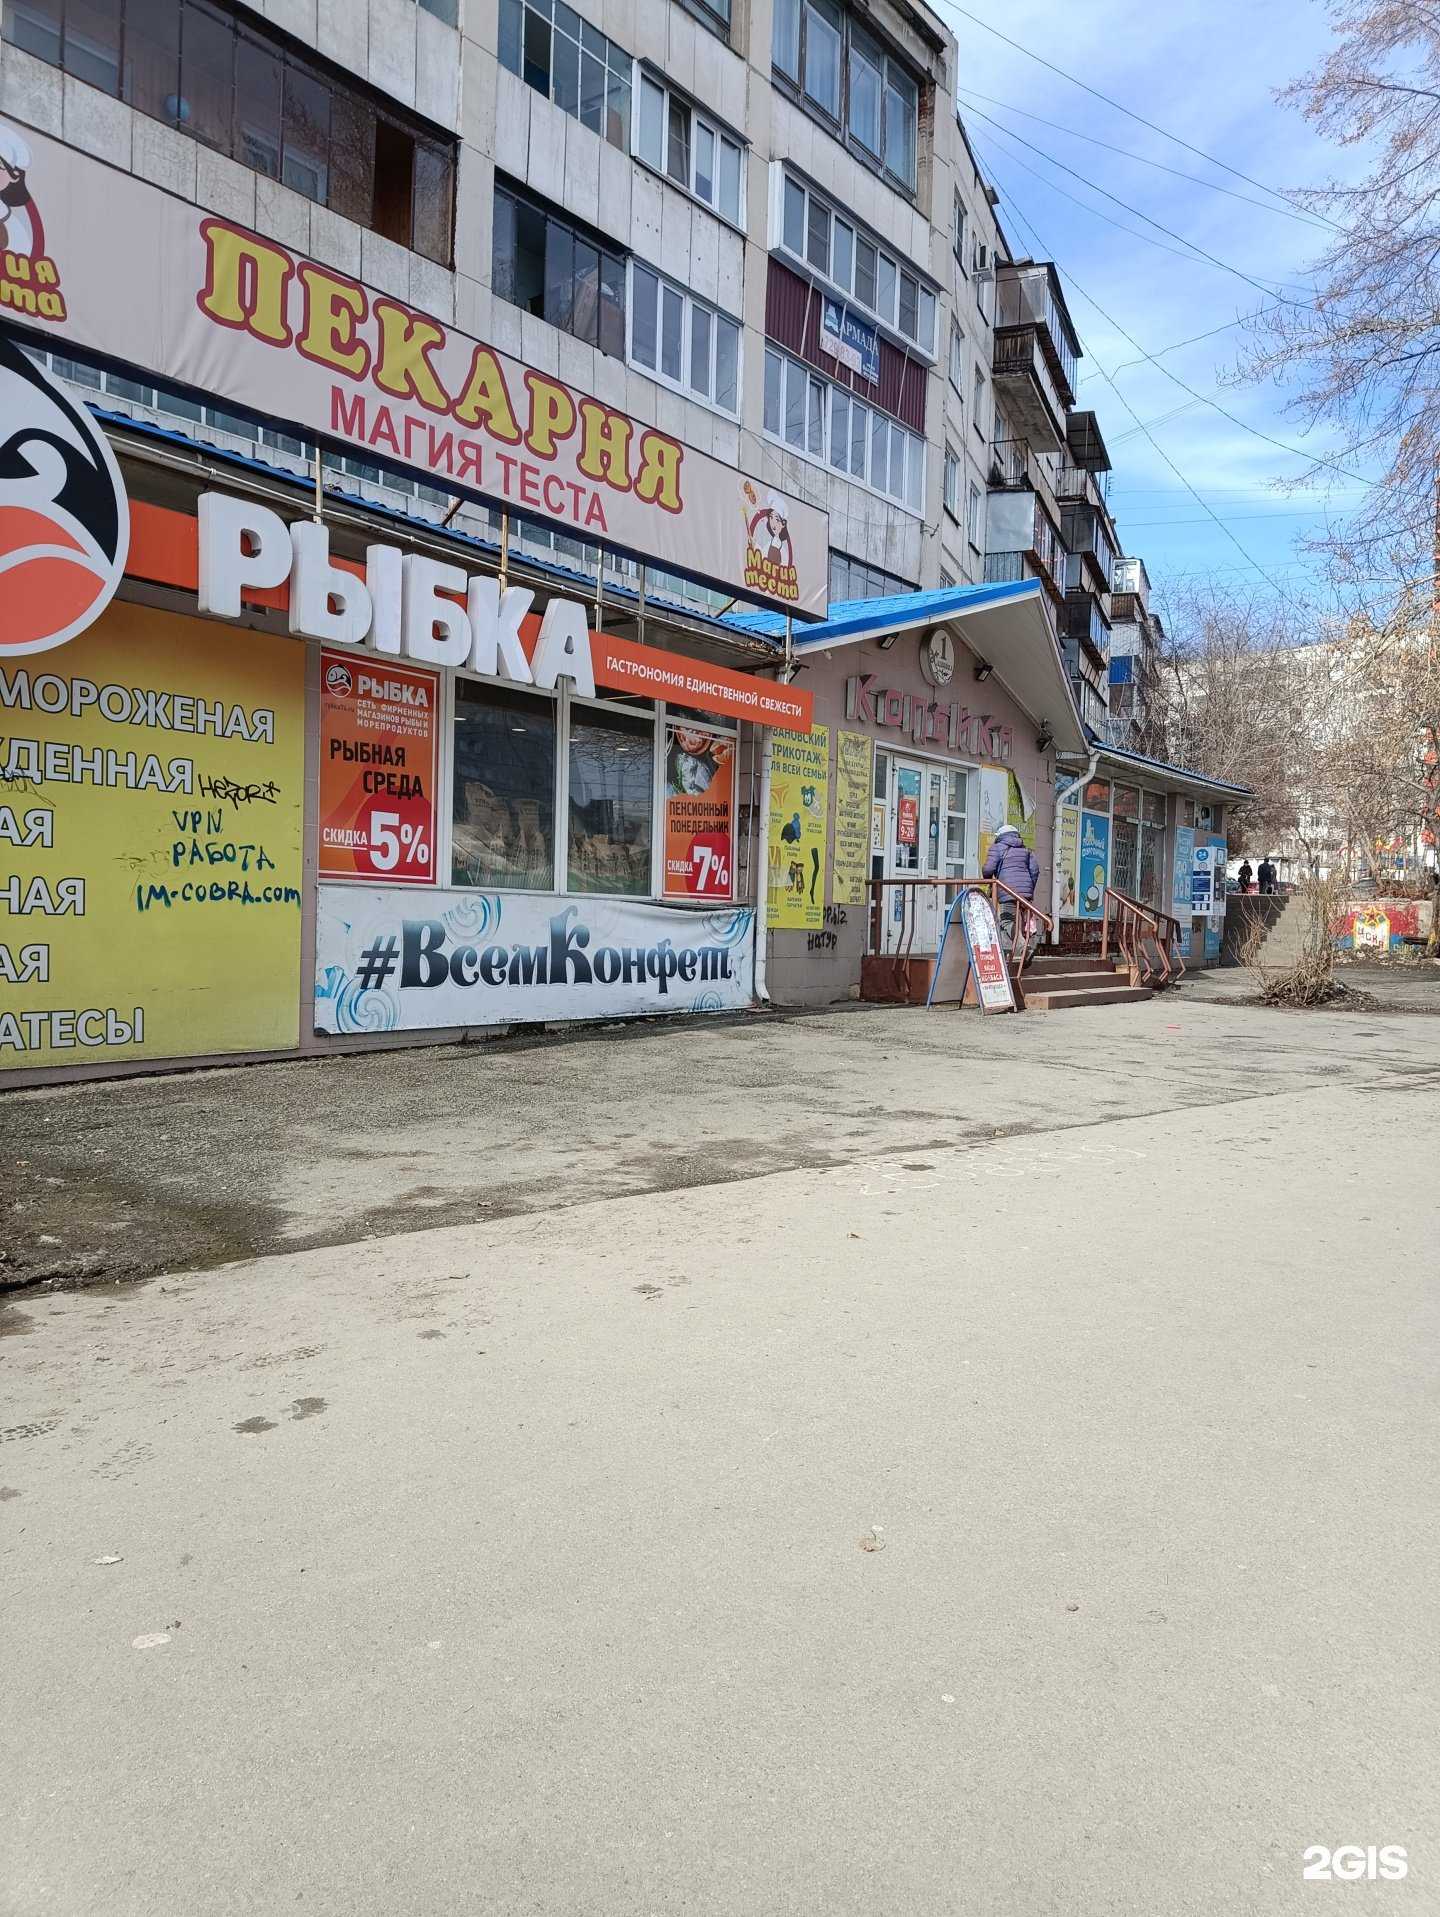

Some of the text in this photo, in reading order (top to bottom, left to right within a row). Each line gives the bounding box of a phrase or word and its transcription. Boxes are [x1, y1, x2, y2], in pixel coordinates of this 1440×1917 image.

[197, 217, 682, 514] ПЕКАРНЯ
[330, 385, 609, 533] МАГИЯ ТЕСТА
[746, 547, 797, 582] Магия
[198, 491, 597, 699] РЫБКА
[744, 568, 799, 600] теста
[358, 675, 429, 707] РЫБКА
[606, 656, 802, 716] ГАСТРОНОМИЯ ЕДИНСТВЕННОЙ СВЕЖЕСТИ
[357, 700, 377, 710] СЕТЬ
[381, 704, 429, 718] ФИРМЕННЫХ
[357, 708, 400, 723] МАГАЗИНОВ
[357, 719, 428, 738] МОРЕПРОДУКТОВ
[0, 738, 194, 795] ДЕННАЯ
[330, 738, 406, 768] РЫБНАЯ
[772, 742, 821, 765] ТРИКОТАЖ
[362, 770, 424, 800] СРЕДА
[803, 766, 827, 780] СЕМЬИ
[172, 807, 223, 835] VPN
[669, 800, 729, 817] ПЕНСИОННЫЙ
[323, 810, 429, 871] СКИДКА 5%
[670, 819, 729, 834] ПОНЕДЕЛЬНИК
[172, 838, 275, 871] РАБОТА
[667, 845, 728, 891] СКИДКА 7%
[356, 904, 732, 995] #ВсемКонфет
